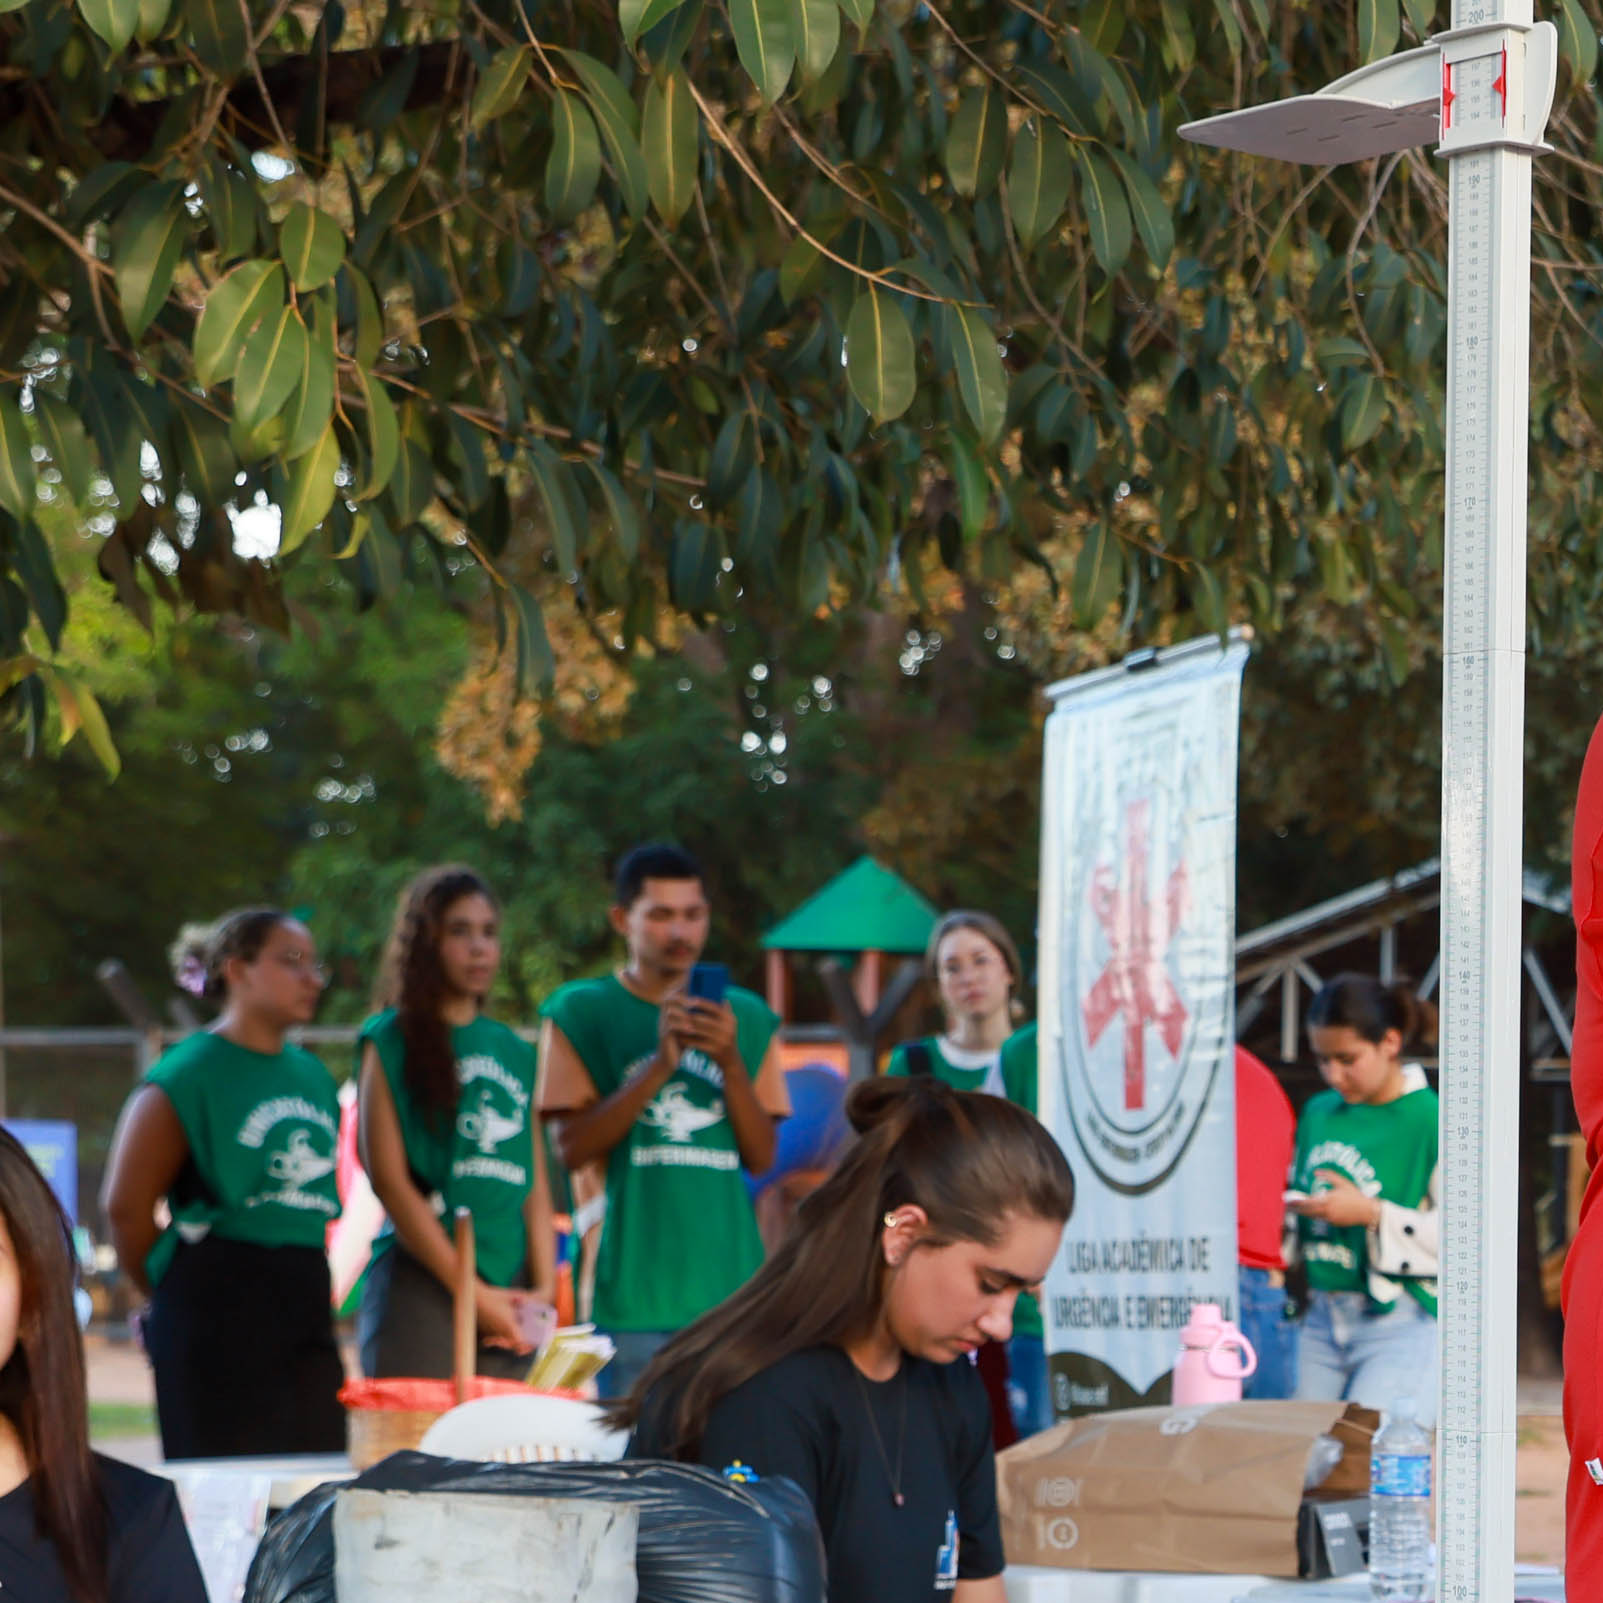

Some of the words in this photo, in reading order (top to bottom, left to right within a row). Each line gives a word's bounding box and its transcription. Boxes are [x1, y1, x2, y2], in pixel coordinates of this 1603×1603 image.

[1068, 1239, 1099, 1273] LIGA
[1189, 1237, 1210, 1271] DE
[1125, 1296, 1134, 1328] E
